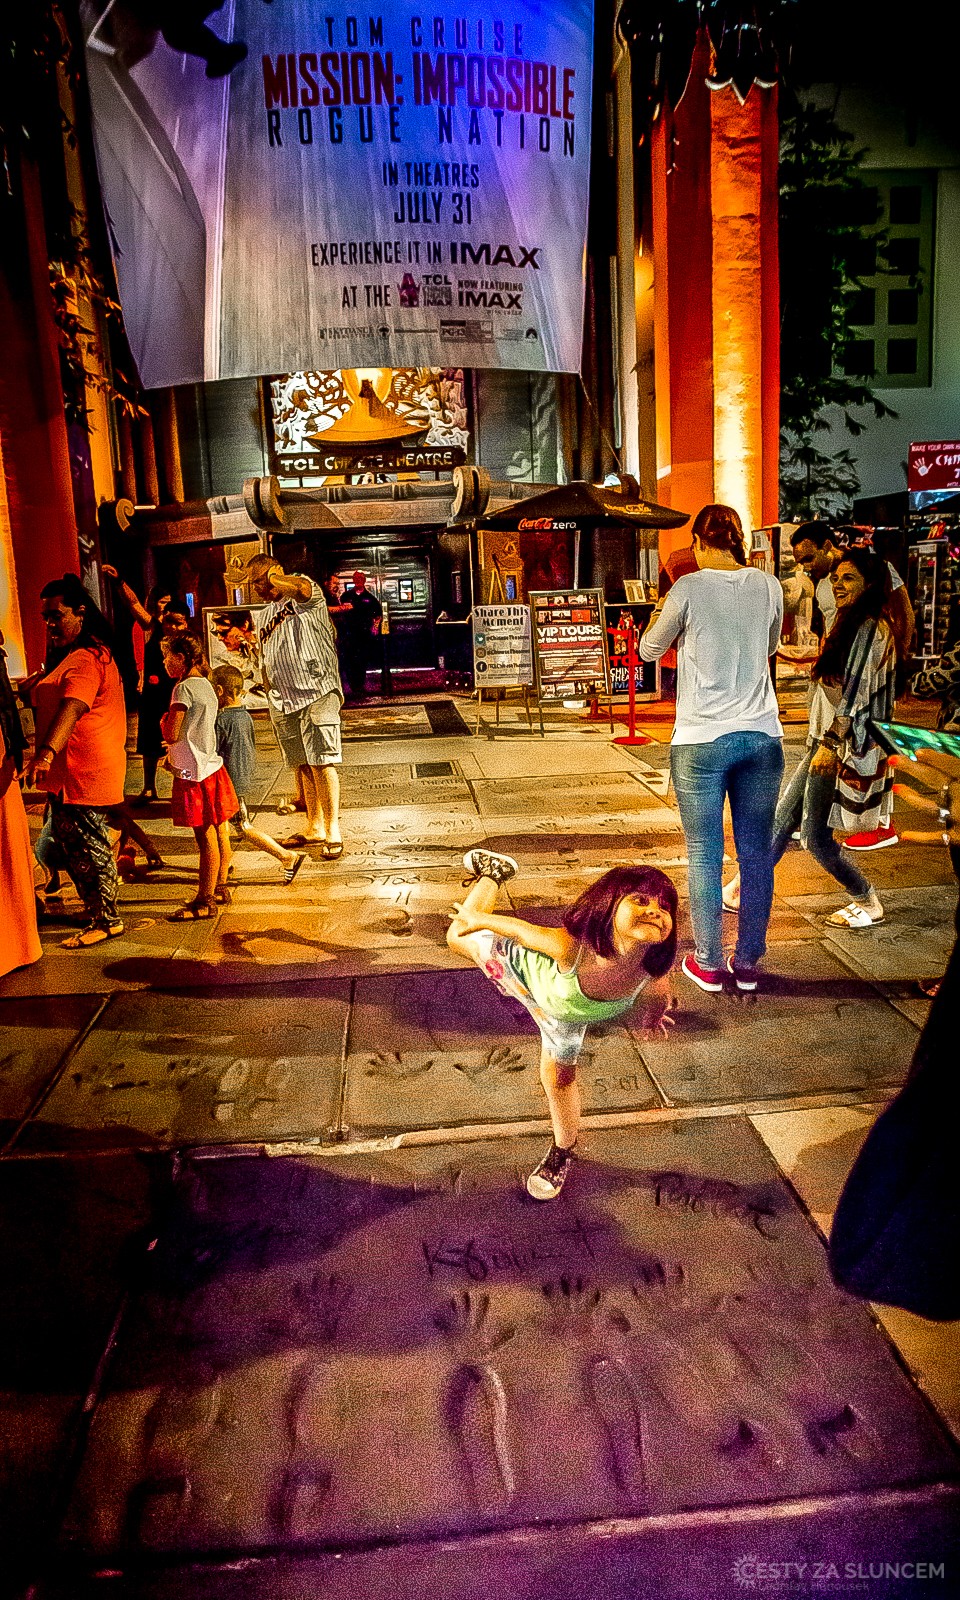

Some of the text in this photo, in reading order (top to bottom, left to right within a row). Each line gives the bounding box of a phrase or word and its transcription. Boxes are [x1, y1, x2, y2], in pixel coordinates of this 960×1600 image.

[325, 16, 523, 55] TOM CRUISE
[262, 52, 575, 120] MISSION: IMPOSSIBLE
[267, 106, 575, 158] ROGUE NATION
[383, 162, 479, 188] IN THEATRES
[394, 192, 471, 225] JULY 31
[311, 240, 542, 269] EXPERIENCE IT IN IMAX
[422, 274, 452, 285] TCL
[458, 280, 523, 291] NOW FEATURING
[342, 284, 391, 308] AT THE
[458, 291, 522, 310] IMAX
[281, 458, 319, 471] TCL
[388, 451, 453, 467] HEATRE
[552, 522, 577, 530] zero
[474, 606, 529, 618] Share This
[482, 616, 524, 626] Moment
[537, 625, 603, 638] VIP TOURS
[610, 654, 644, 667] TCL
[610, 666, 643, 676] CHINSE
[610, 673, 644, 682] THEARE
